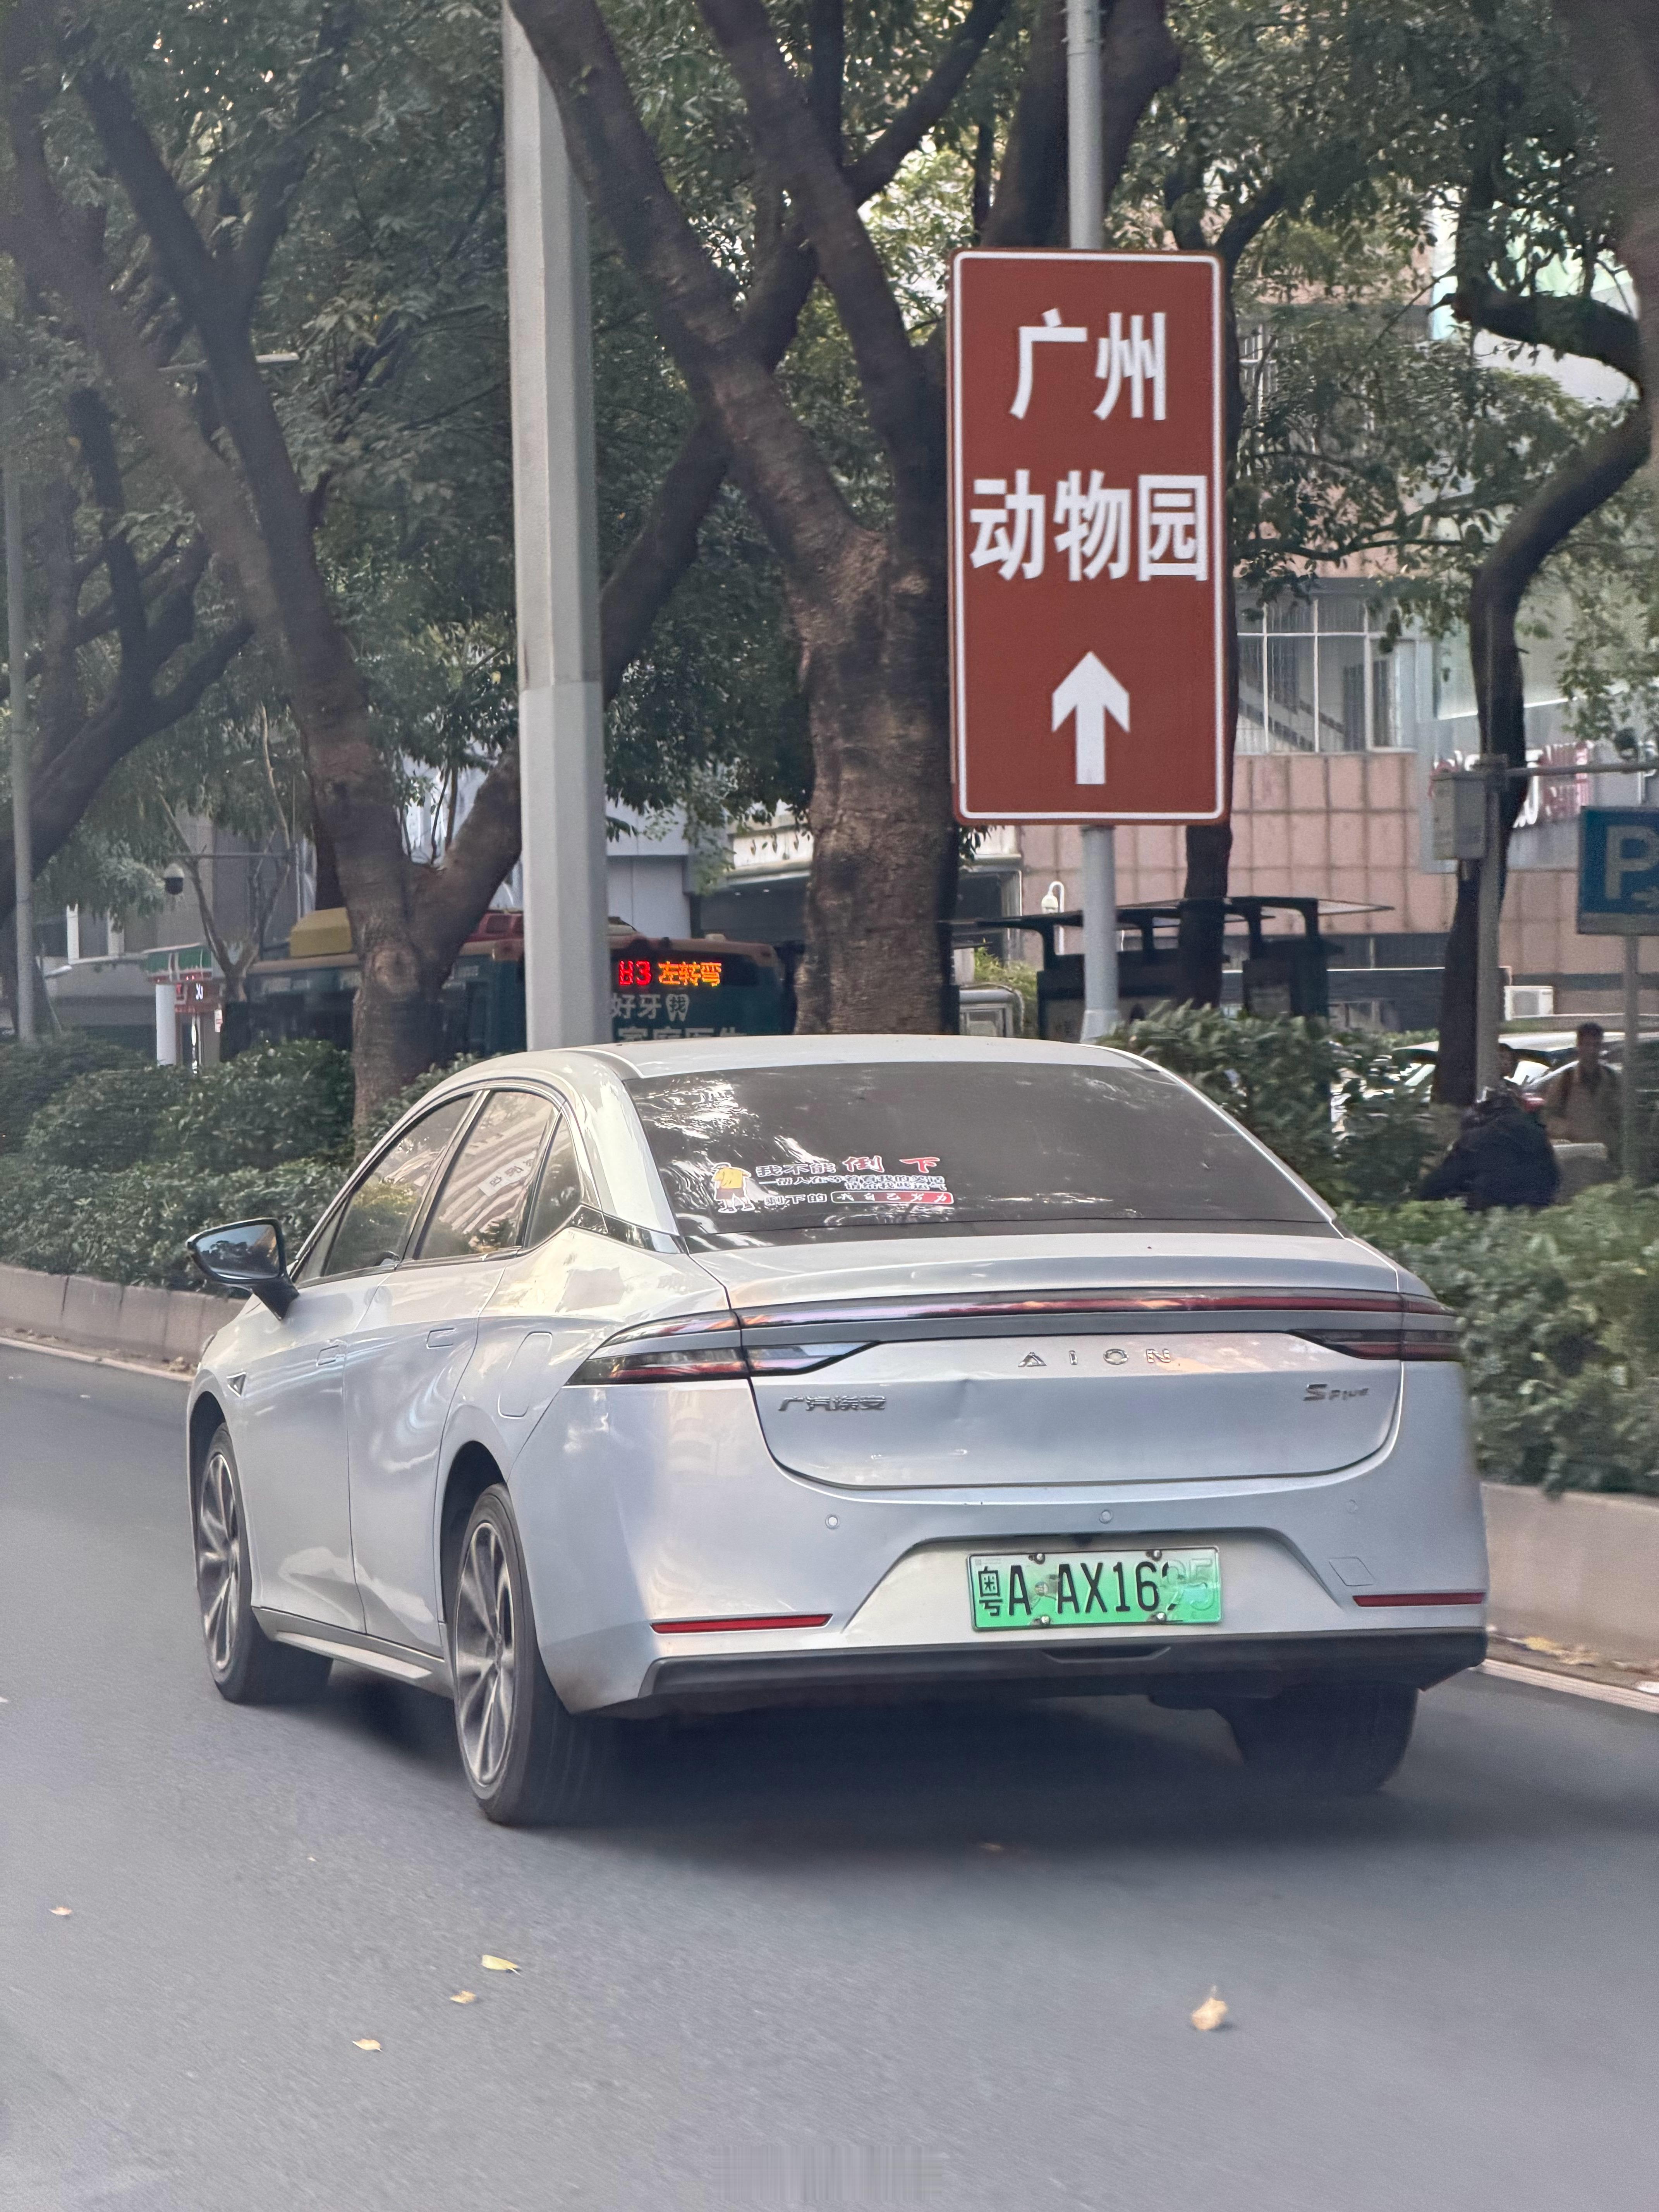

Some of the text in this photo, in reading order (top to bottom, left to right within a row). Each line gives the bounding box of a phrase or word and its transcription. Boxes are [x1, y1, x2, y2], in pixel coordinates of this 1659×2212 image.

[1008, 307, 1166, 421] 广州
[969, 469, 1208, 582] 动物园
[1605, 825, 1659, 900] P
[658, 960, 722, 987] 左转弯
[1018, 1348, 1171, 1368] AION
[778, 1395, 885, 1411] 广汽埃安
